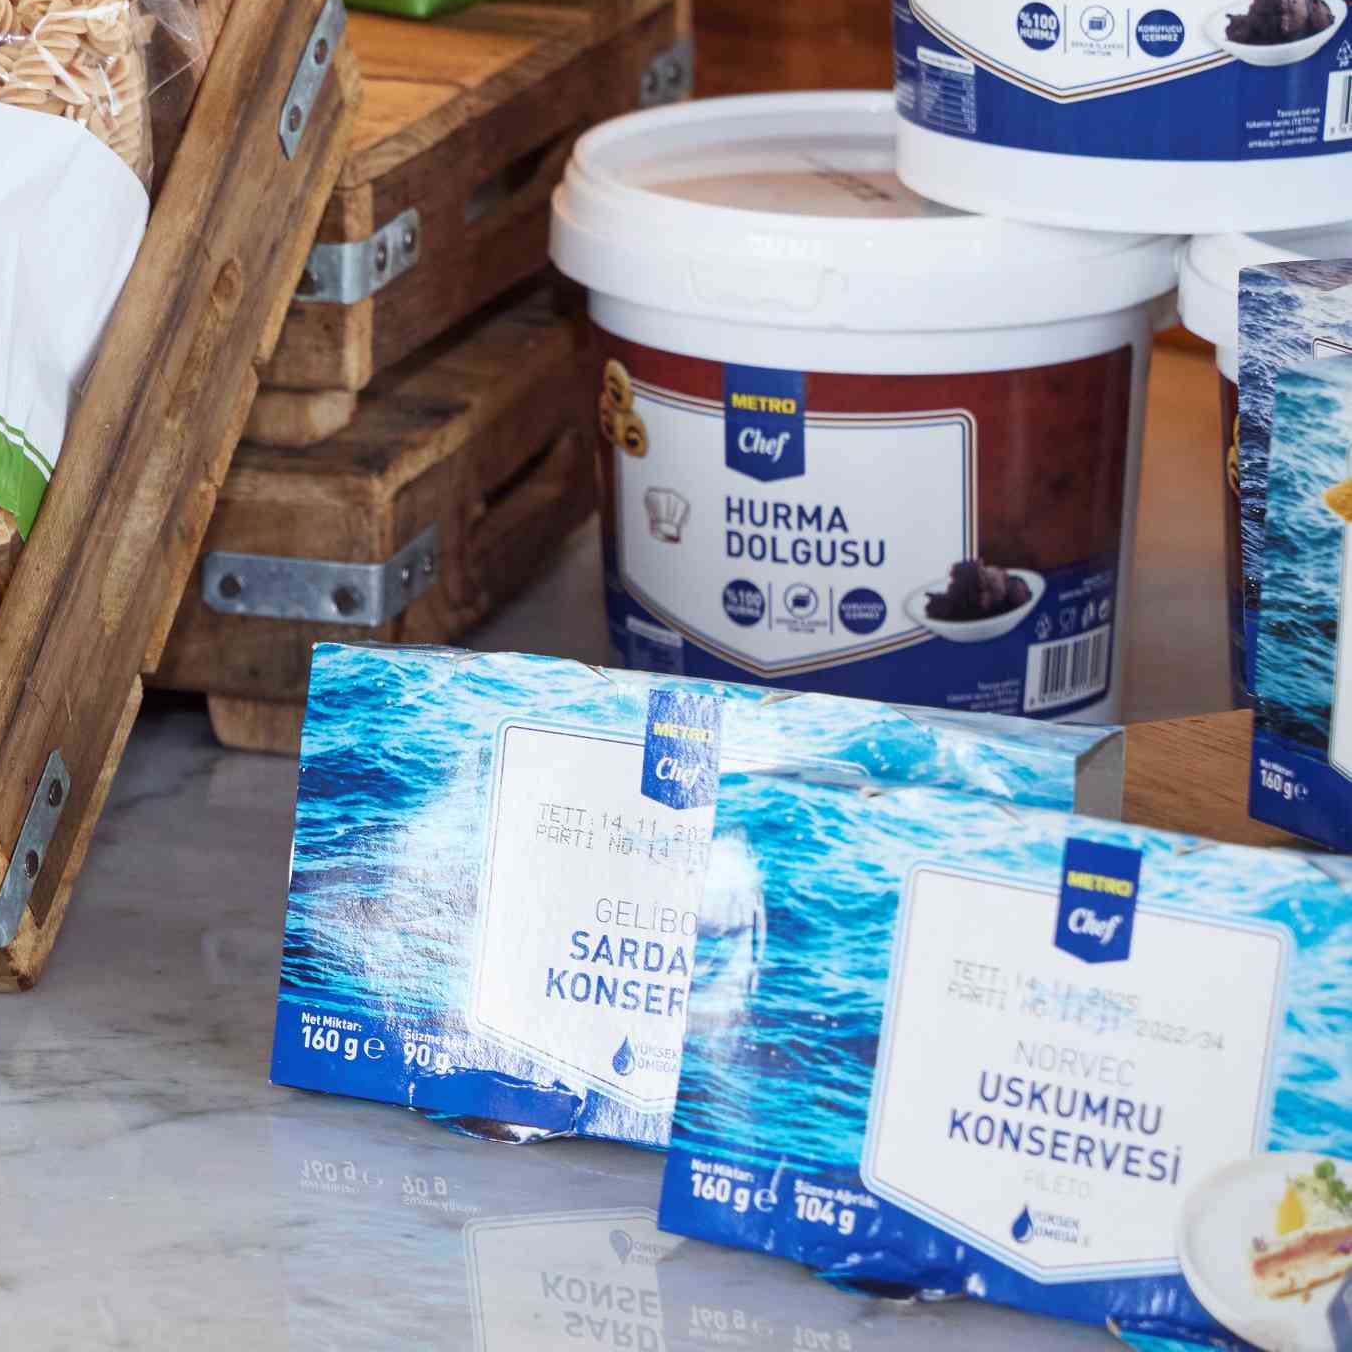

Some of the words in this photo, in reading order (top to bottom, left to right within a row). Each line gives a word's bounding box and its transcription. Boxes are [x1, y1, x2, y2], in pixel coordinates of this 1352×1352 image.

[1019, 10, 1059, 30] %100
[1019, 27, 1058, 42] HURMA
[1137, 24, 1184, 35] KORUYUCU
[731, 391, 797, 415] METRO
[738, 427, 791, 461] Chef
[726, 496, 849, 533] HURMA
[726, 531, 886, 568] DOLGUSU
[725, 588, 763, 608] %100
[653, 721, 712, 744] METRO
[655, 756, 698, 788] Chef
[1260, 769, 1283, 793] 160
[1282, 781, 1294, 801] g
[1066, 870, 1134, 898] METRO
[1067, 905, 1123, 944] Chef
[569, 929, 688, 977] SARDA
[301, 1012, 322, 1026] Net
[323, 1014, 363, 1033] Miktar:
[301, 1025, 340, 1053] 160
[344, 1037, 359, 1062] g
[403, 1041, 431, 1068] 90
[978, 1070, 1164, 1136] USKUMRU
[948, 1109, 1183, 1186] KONSERVESİ
[691, 1158, 713, 1173] Net
[691, 1172, 732, 1204] 160
[733, 1187, 750, 1213] g
[796, 1194, 835, 1226] 104
[838, 1209, 856, 1235] g
